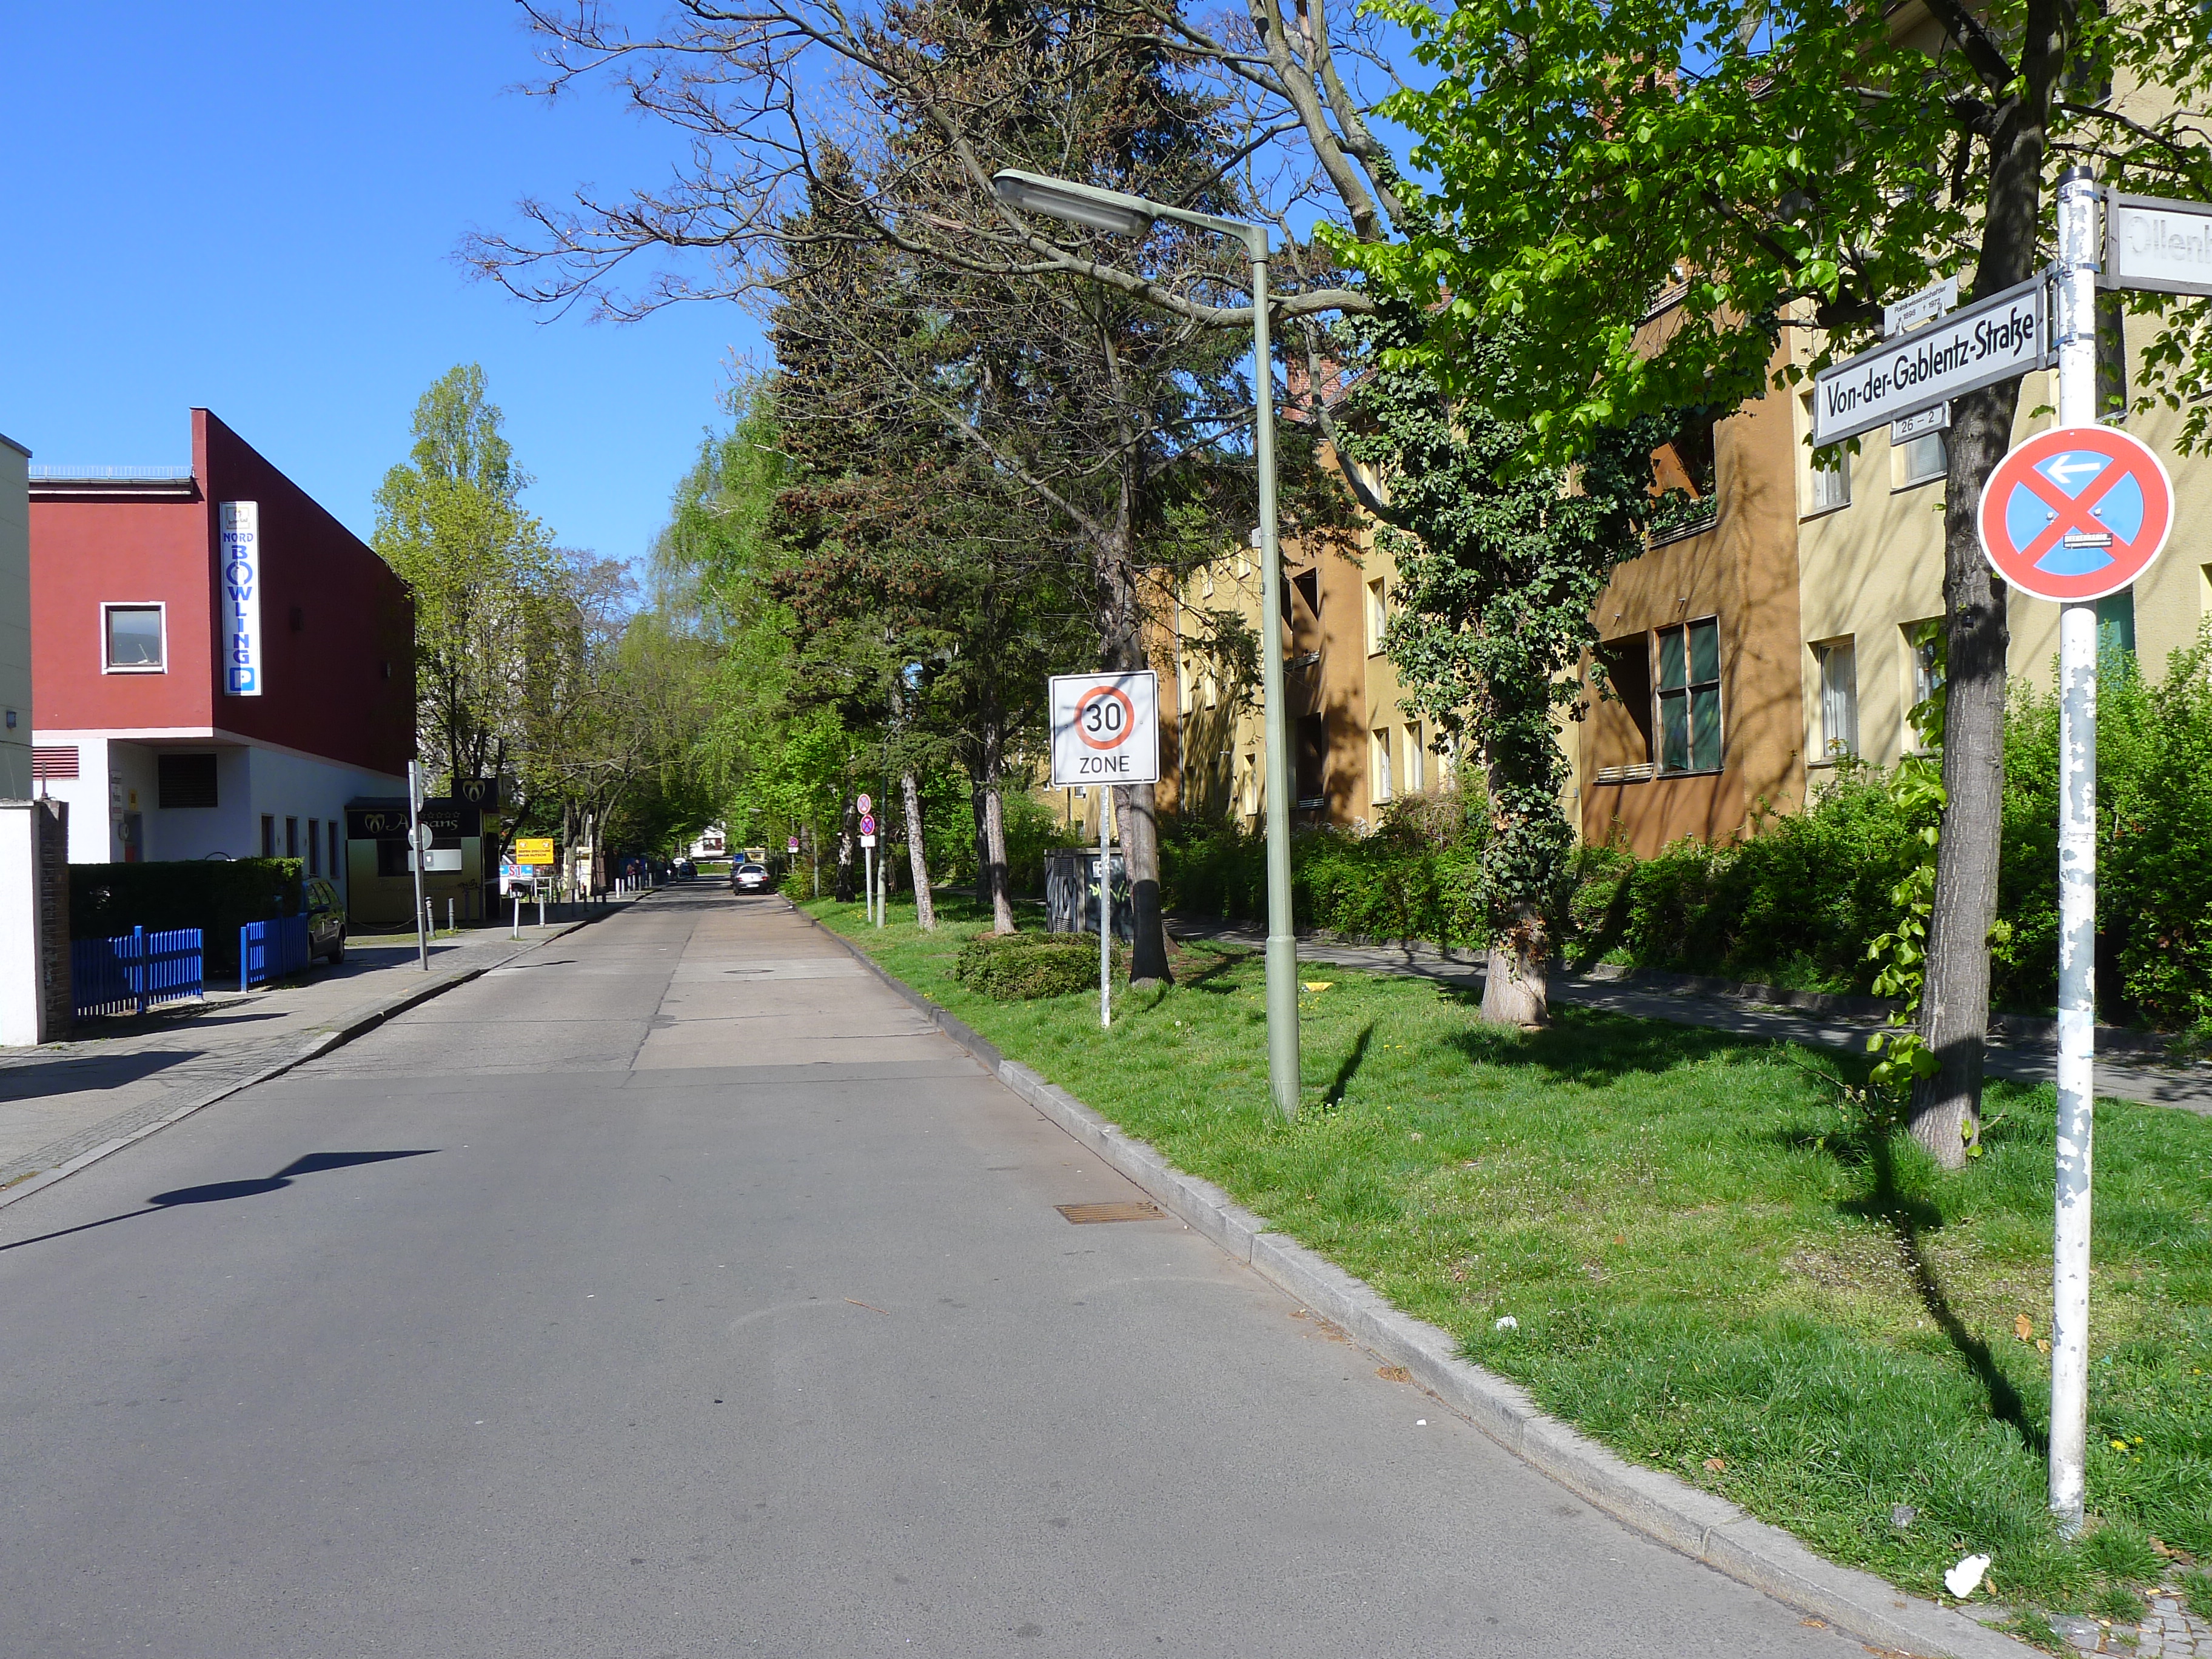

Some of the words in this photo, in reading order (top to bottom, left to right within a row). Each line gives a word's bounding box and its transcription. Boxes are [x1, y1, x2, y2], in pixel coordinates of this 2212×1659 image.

[1828, 306, 2034, 418] Von-der-Gablentz-Straße
[1901, 418, 1914, 433] 26
[1928, 412, 1934, 423] 2
[223, 533, 253, 543] NORD
[226, 545, 253, 664] BOWLING
[1086, 703, 1121, 731] 30
[1079, 756, 1130, 774] ZONE
[509, 865, 521, 877] S1
